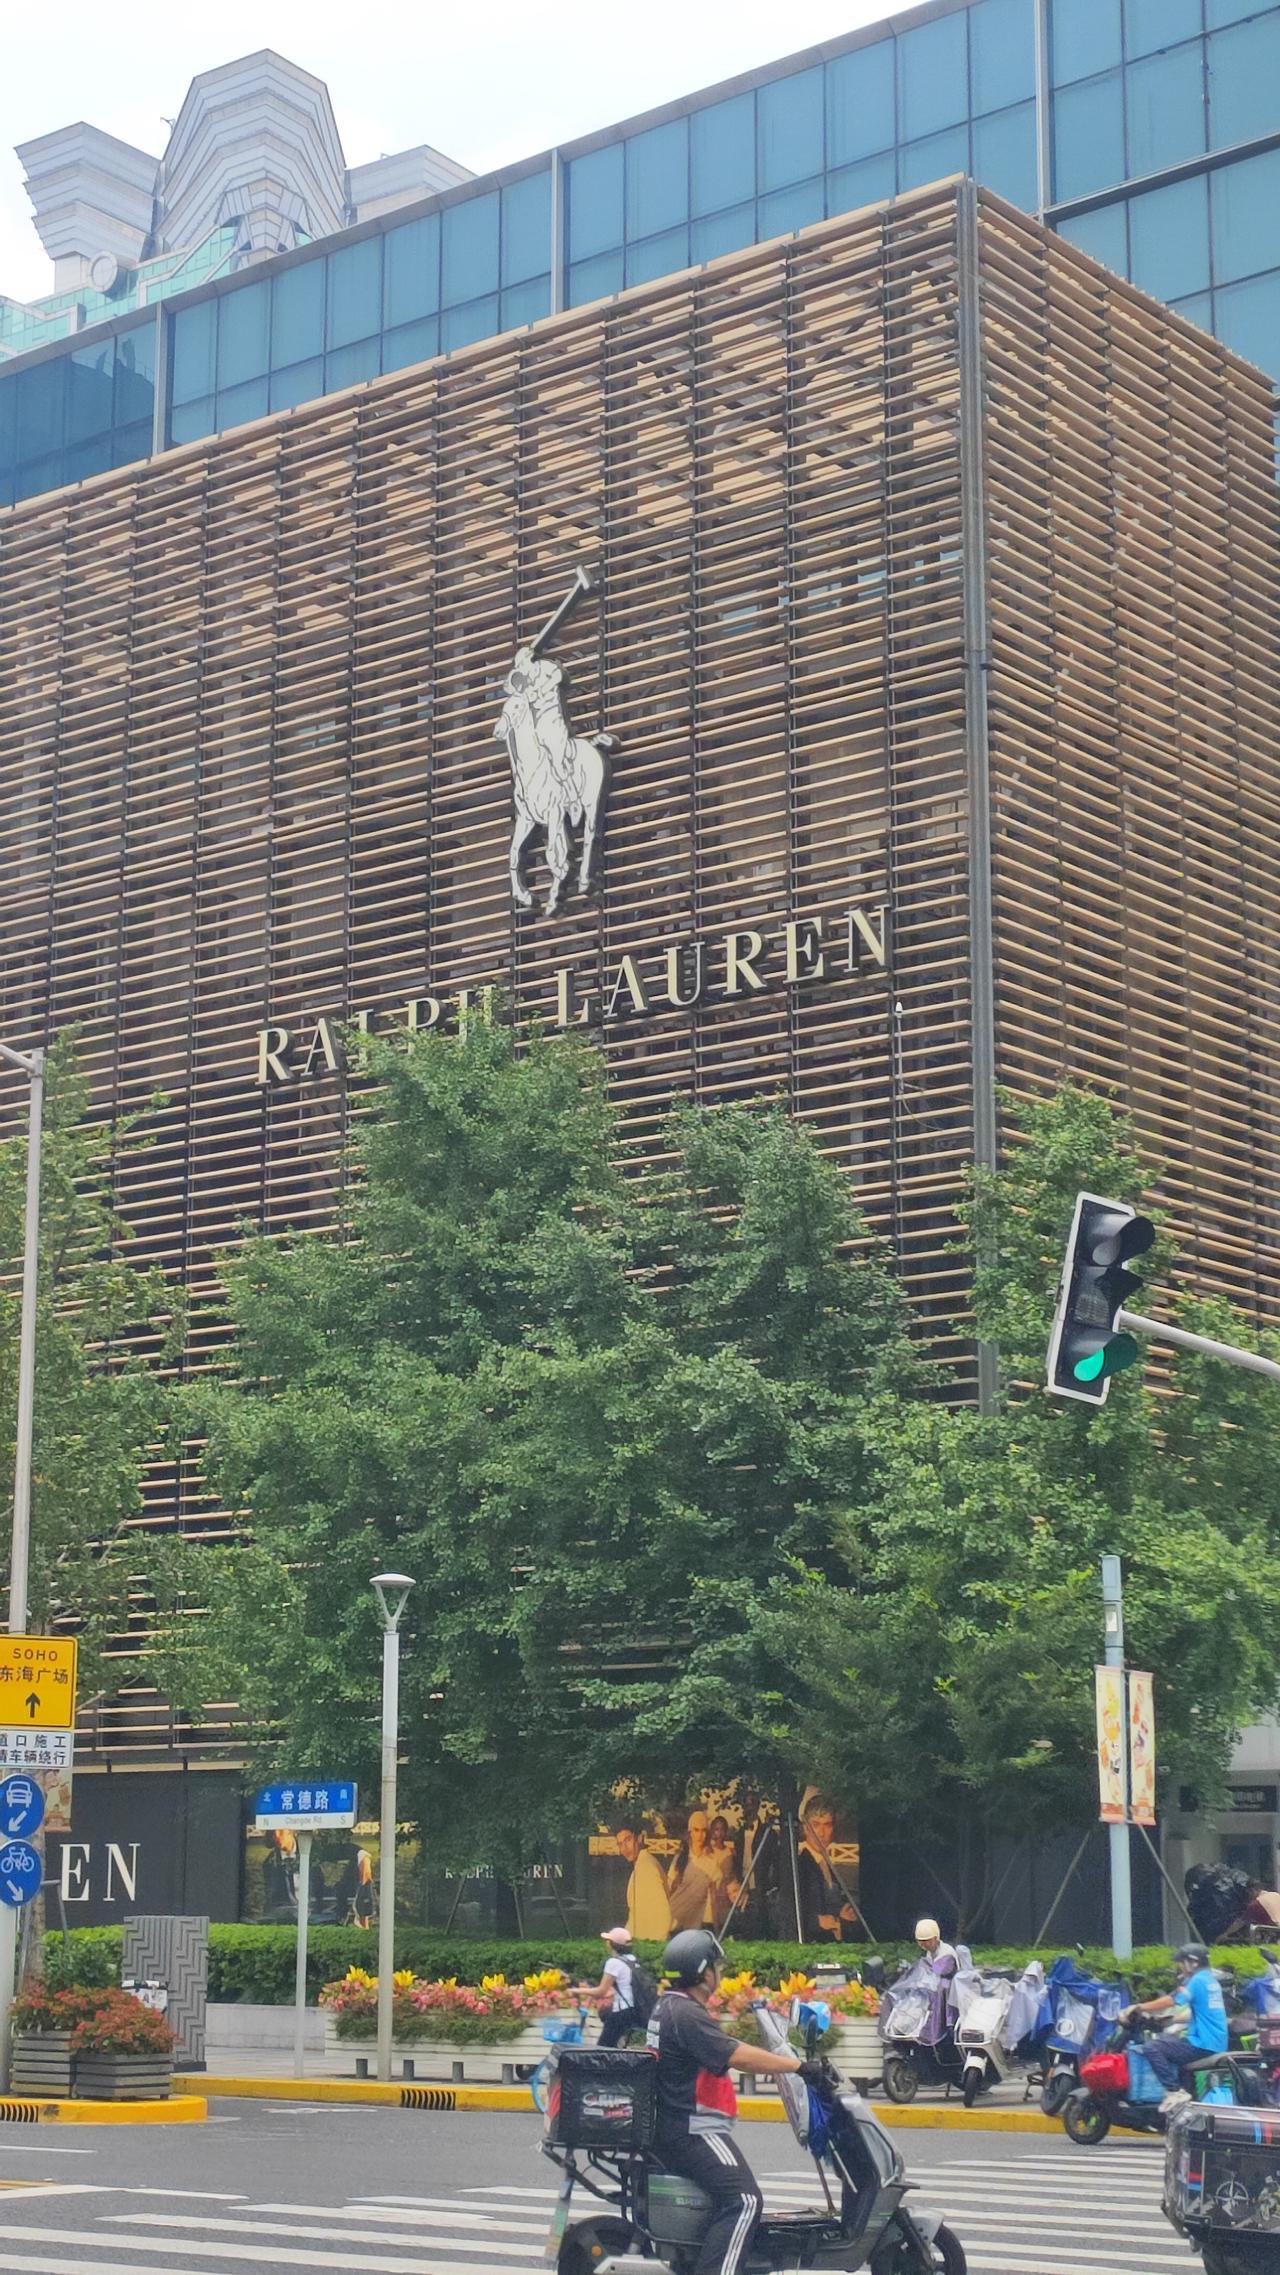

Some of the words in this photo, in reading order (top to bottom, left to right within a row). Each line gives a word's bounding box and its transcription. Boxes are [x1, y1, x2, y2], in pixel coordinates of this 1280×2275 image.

[553, 904, 891, 1027] LAUREN
[13, 1648, 58, 1661] SOHO
[0, 1665, 69, 1684] 东海广场
[281, 1789, 328, 1810] 常德路
[340, 1815, 346, 1824] S
